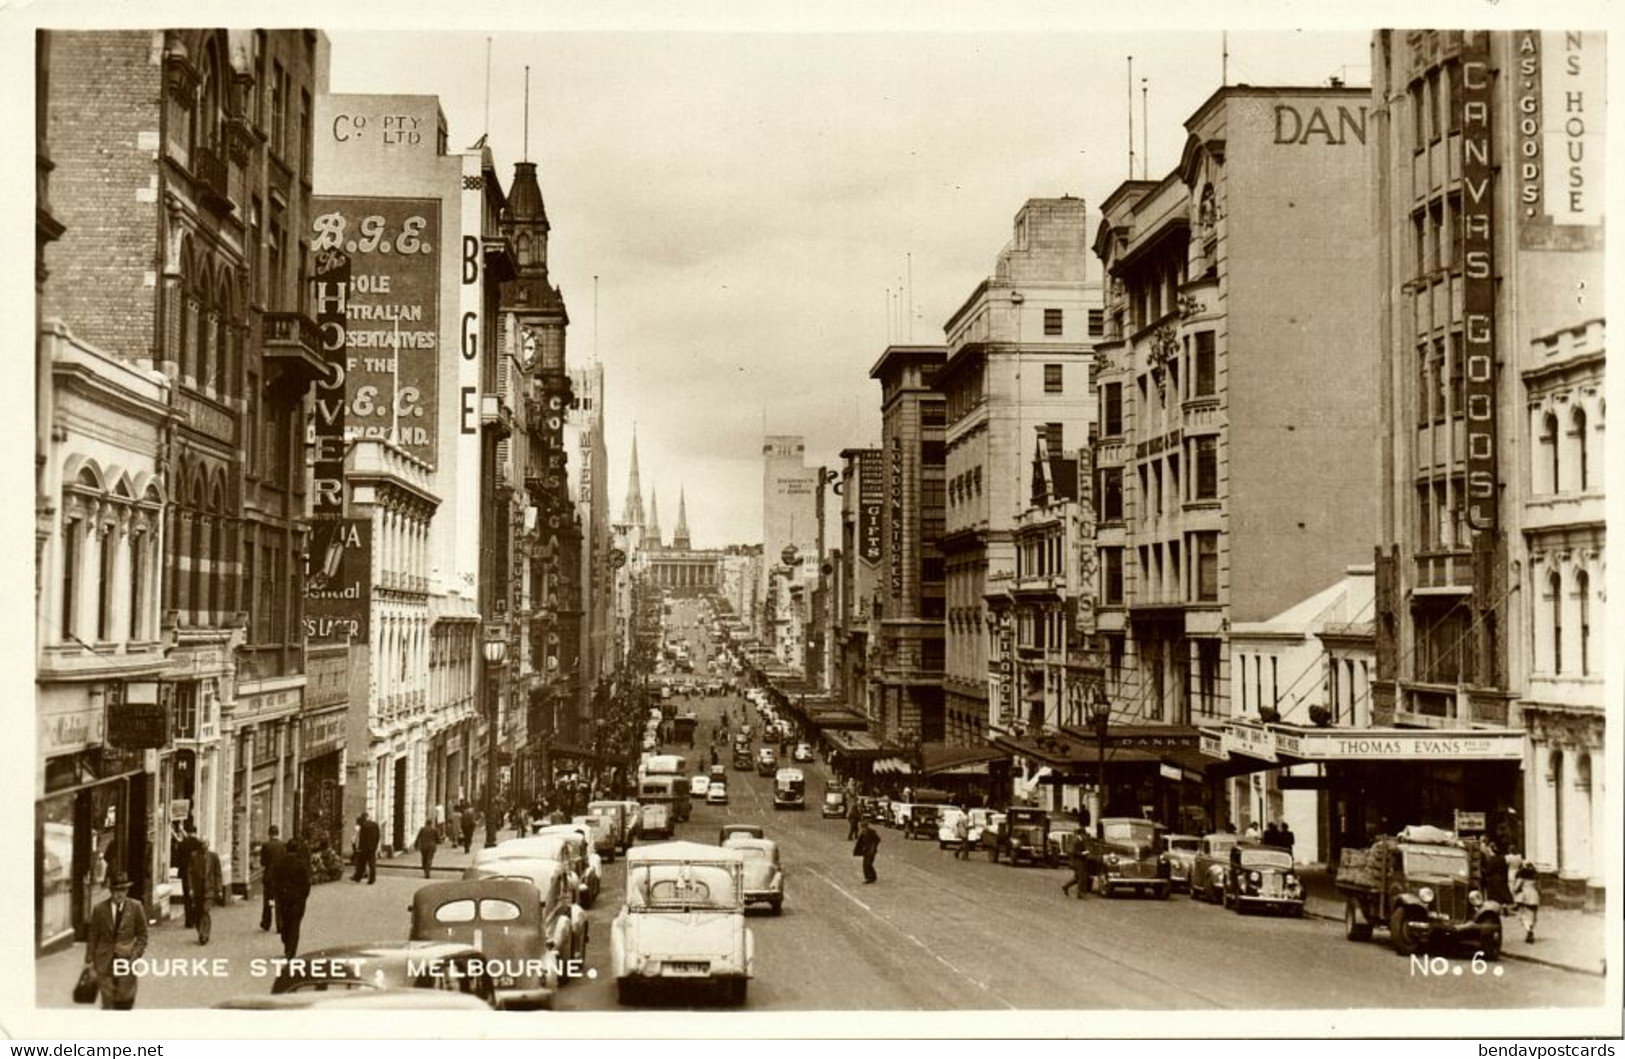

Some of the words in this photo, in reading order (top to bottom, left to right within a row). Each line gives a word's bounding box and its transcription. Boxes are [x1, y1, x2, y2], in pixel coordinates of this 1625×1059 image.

[383, 115, 422, 129] PTY
[383, 131, 421, 144] LTD
[1273, 105, 1367, 146] DAN
[1565, 91, 1585, 213] HOUSE
[462, 175, 484, 191] 388
[1463, 62, 1490, 280] CANVAS
[346, 330, 436, 349] SENTATIVES
[313, 281, 347, 506] HOOVER
[1466, 313, 1492, 499] GOODS
[548, 395, 562, 489] COLES
[579, 430, 591, 503] MYER
[891, 438, 901, 508] LONDON
[867, 506, 880, 558] GIFTS
[1000, 613, 1011, 715] METROPOLE
[1120, 737, 1191, 747] DANKS
[1338, 740, 1402, 755] THOMAS
[1414, 740, 1461, 755] EVANS
